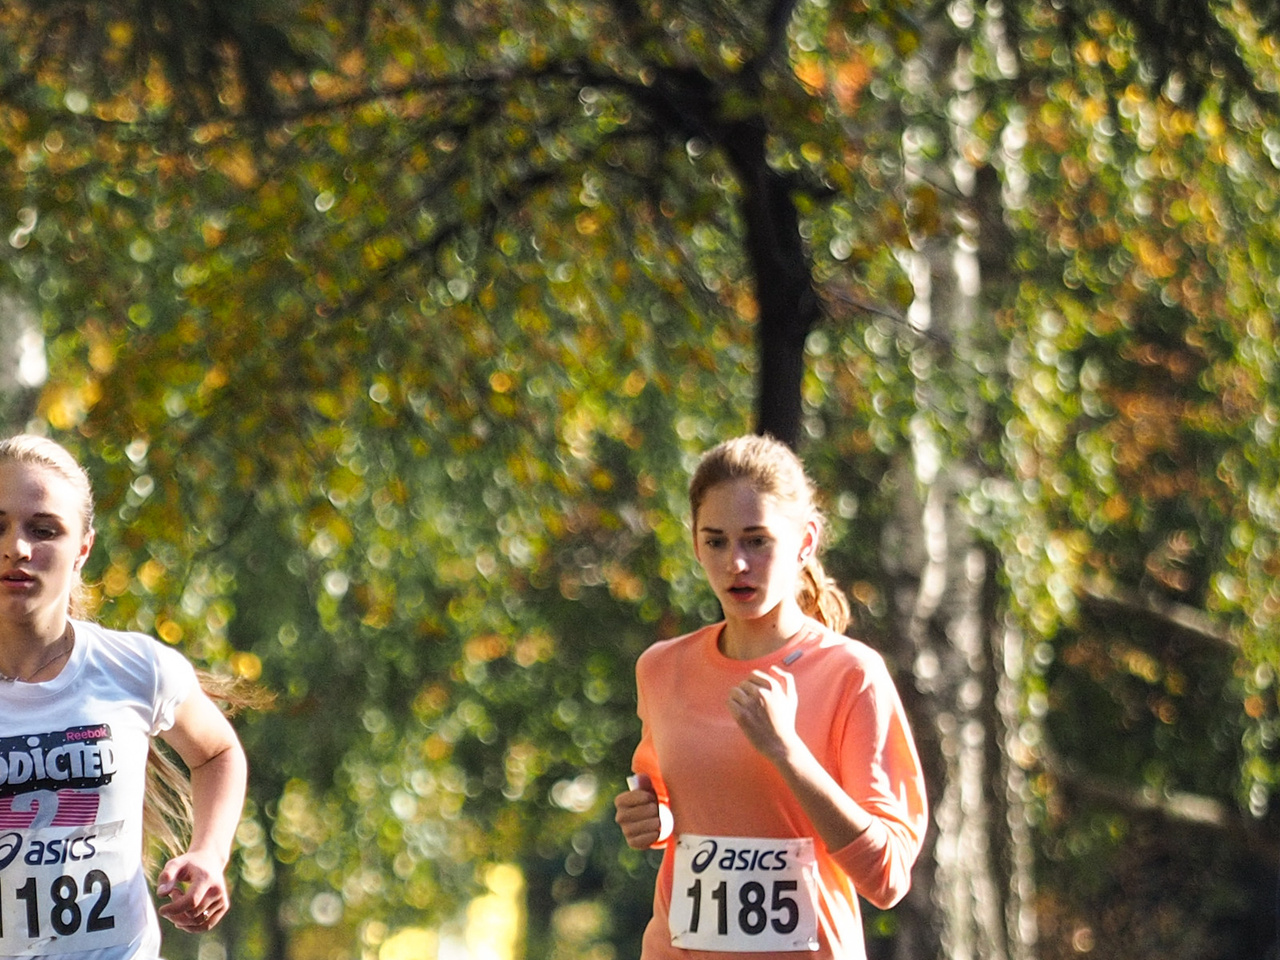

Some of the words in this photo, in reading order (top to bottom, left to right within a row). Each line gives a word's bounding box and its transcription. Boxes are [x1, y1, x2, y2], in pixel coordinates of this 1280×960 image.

[66, 727, 108, 741] Reebok
[24, 835, 96, 866] asics
[718, 849, 788, 872] asics
[687, 879, 799, 935] 1185
